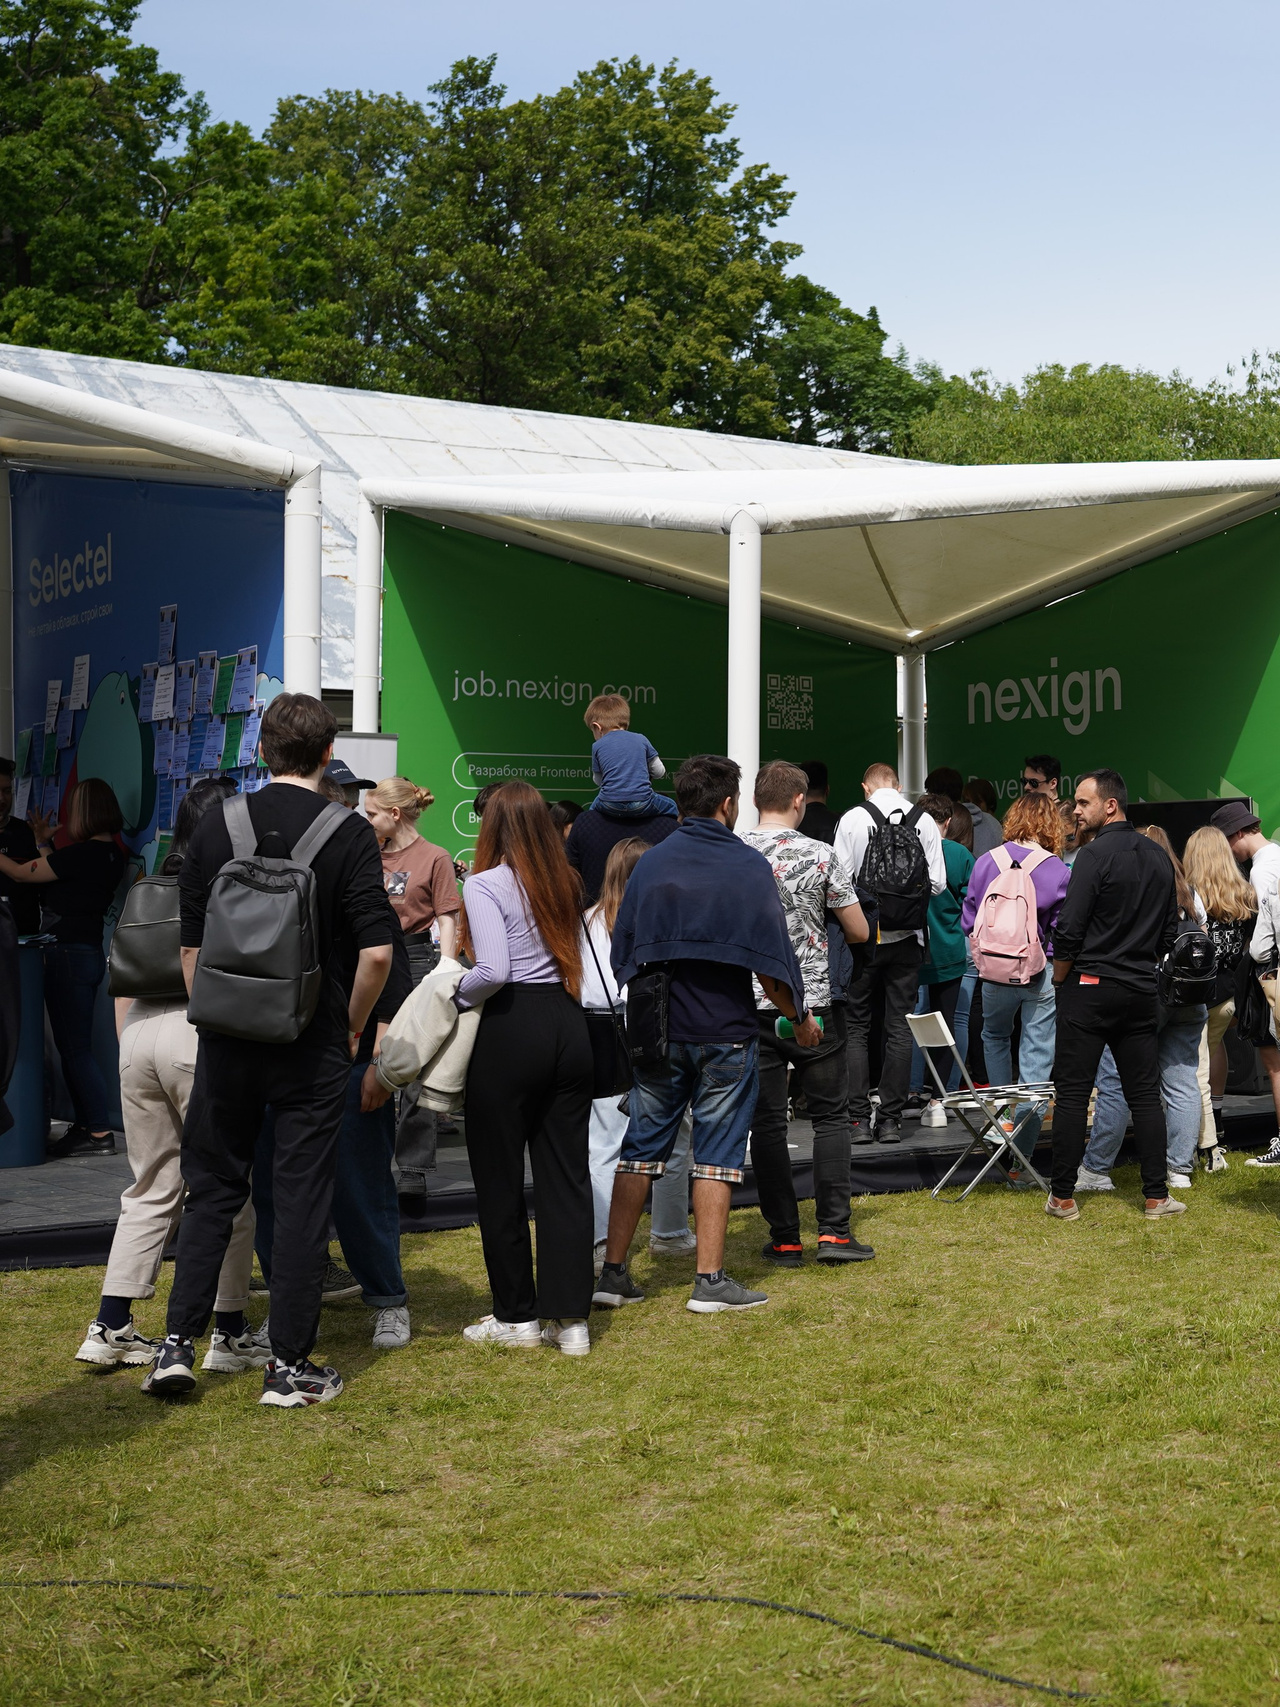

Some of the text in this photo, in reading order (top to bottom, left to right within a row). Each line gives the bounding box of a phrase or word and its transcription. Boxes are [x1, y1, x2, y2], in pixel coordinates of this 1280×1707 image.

[29, 532, 112, 607] Selectel
[81, 604, 98, 624] строй
[453, 670, 656, 706] job.nexigncom
[967, 657, 1122, 735] nexign
[468, 764, 591, 781] Разработка Frontend
